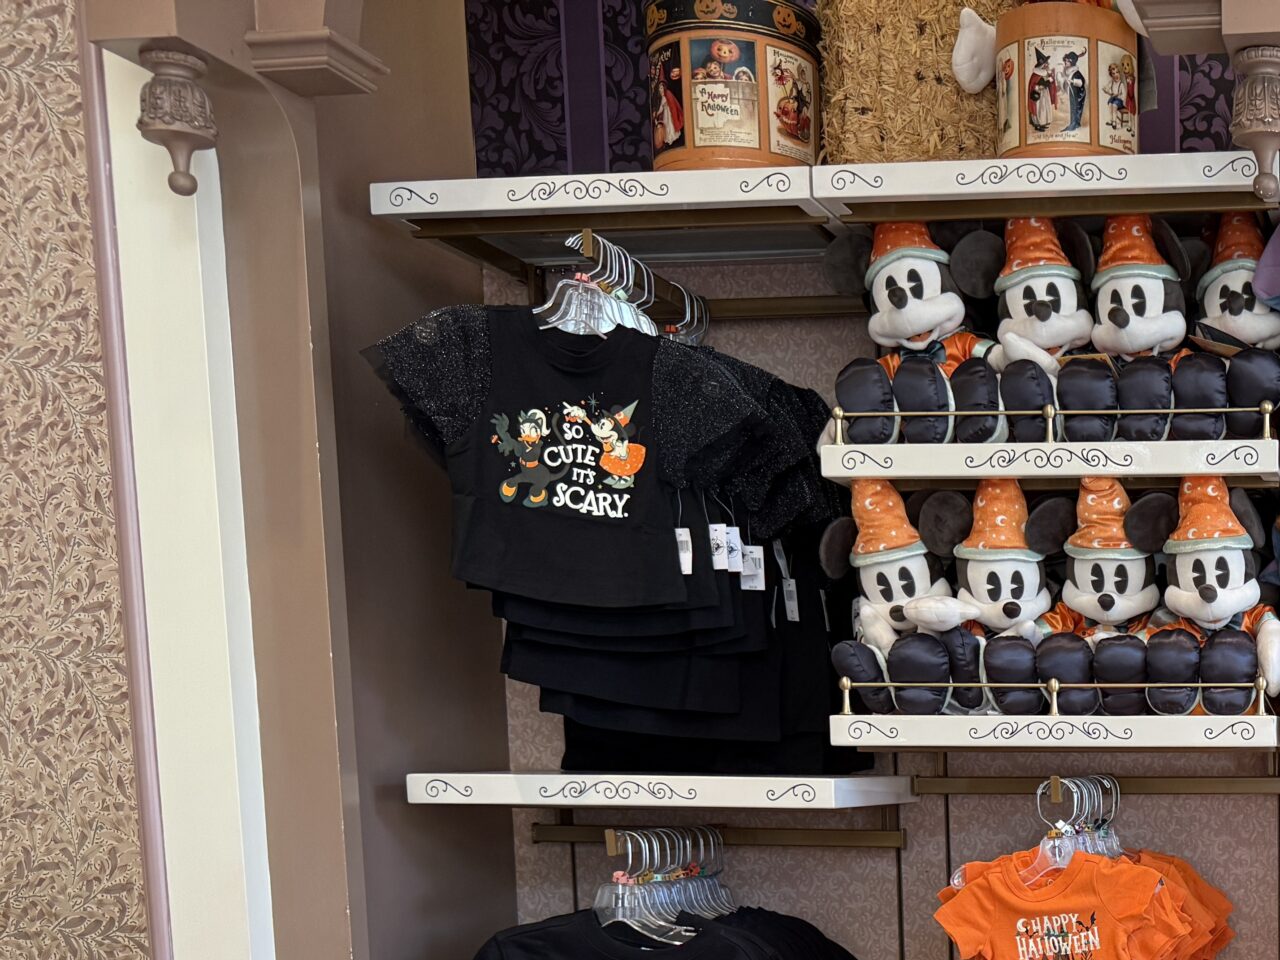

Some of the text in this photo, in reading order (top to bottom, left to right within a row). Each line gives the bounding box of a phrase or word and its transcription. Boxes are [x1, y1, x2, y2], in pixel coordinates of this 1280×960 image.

[562, 422, 584, 440] SO
[543, 443, 600, 467] CUTE
[571, 467, 597, 485] IT'S
[552, 482, 631, 518] SCARY.
[1031, 913, 1079, 936] HAPPY
[1015, 926, 1101, 960] HALLOWEEN
